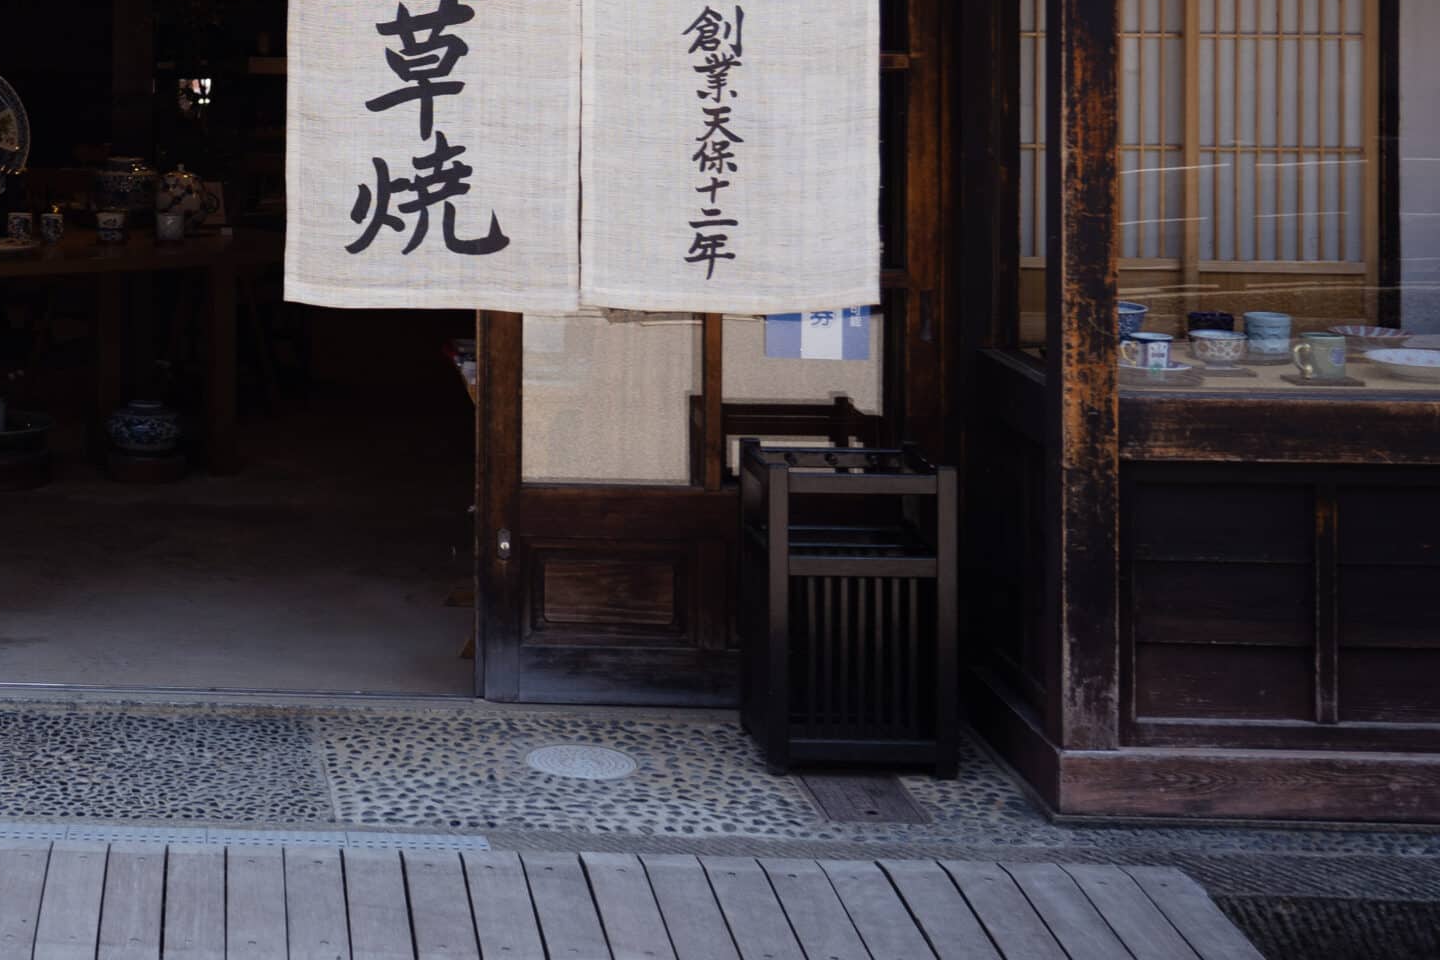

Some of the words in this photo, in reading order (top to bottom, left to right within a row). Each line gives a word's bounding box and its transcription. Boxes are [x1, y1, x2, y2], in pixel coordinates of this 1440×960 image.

[681, 4, 745, 280] 創業天保十二年
